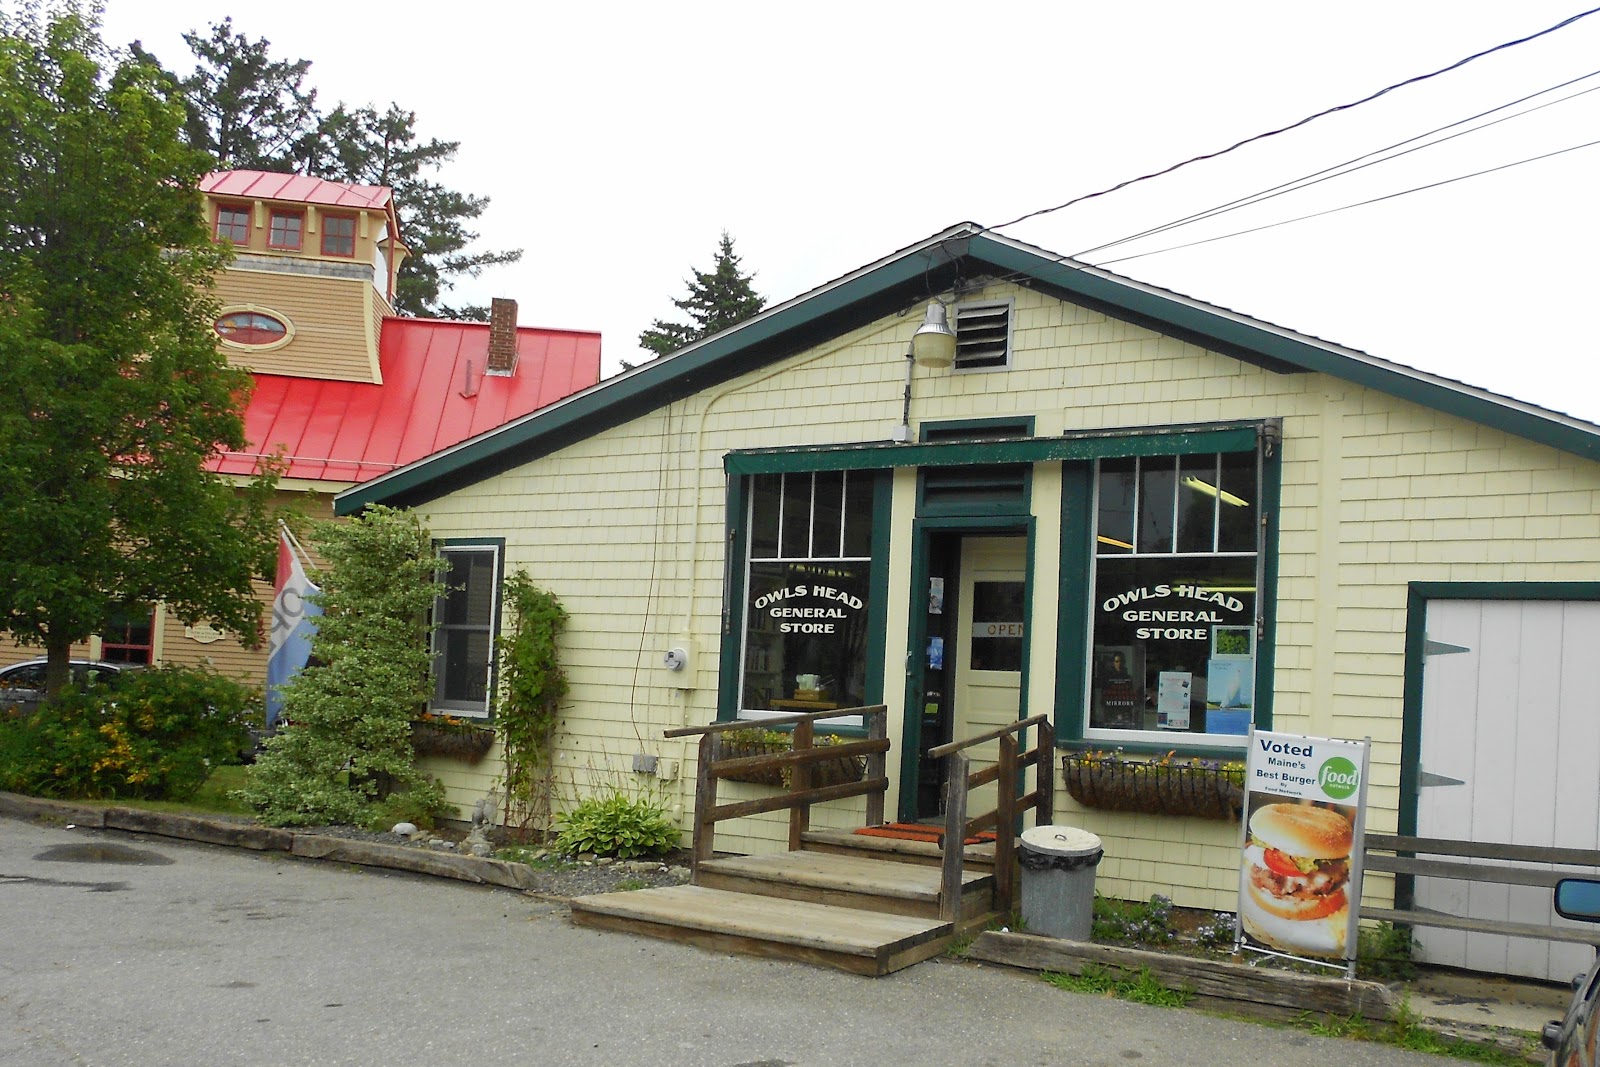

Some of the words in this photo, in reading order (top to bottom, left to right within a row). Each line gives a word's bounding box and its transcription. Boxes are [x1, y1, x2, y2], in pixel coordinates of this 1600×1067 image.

[754, 585, 807, 609] OWLS
[812, 585, 863, 610] HEAD
[1103, 584, 1171, 612] OWLS
[1178, 584, 1244, 612] HEAD
[770, 607, 847, 618] GENERAL
[1122, 610, 1223, 622] GENERAL
[780, 623, 835, 634] STORE
[1136, 627, 1208, 640] STORE
[1260, 739, 1313, 757] Voted
[1268, 757, 1306, 769] Maine's
[1256, 769, 1278, 780] Best
[1282, 773, 1316, 785] Burger
[1321, 765, 1359, 787] food
[1279, 788, 1302, 796] Network
